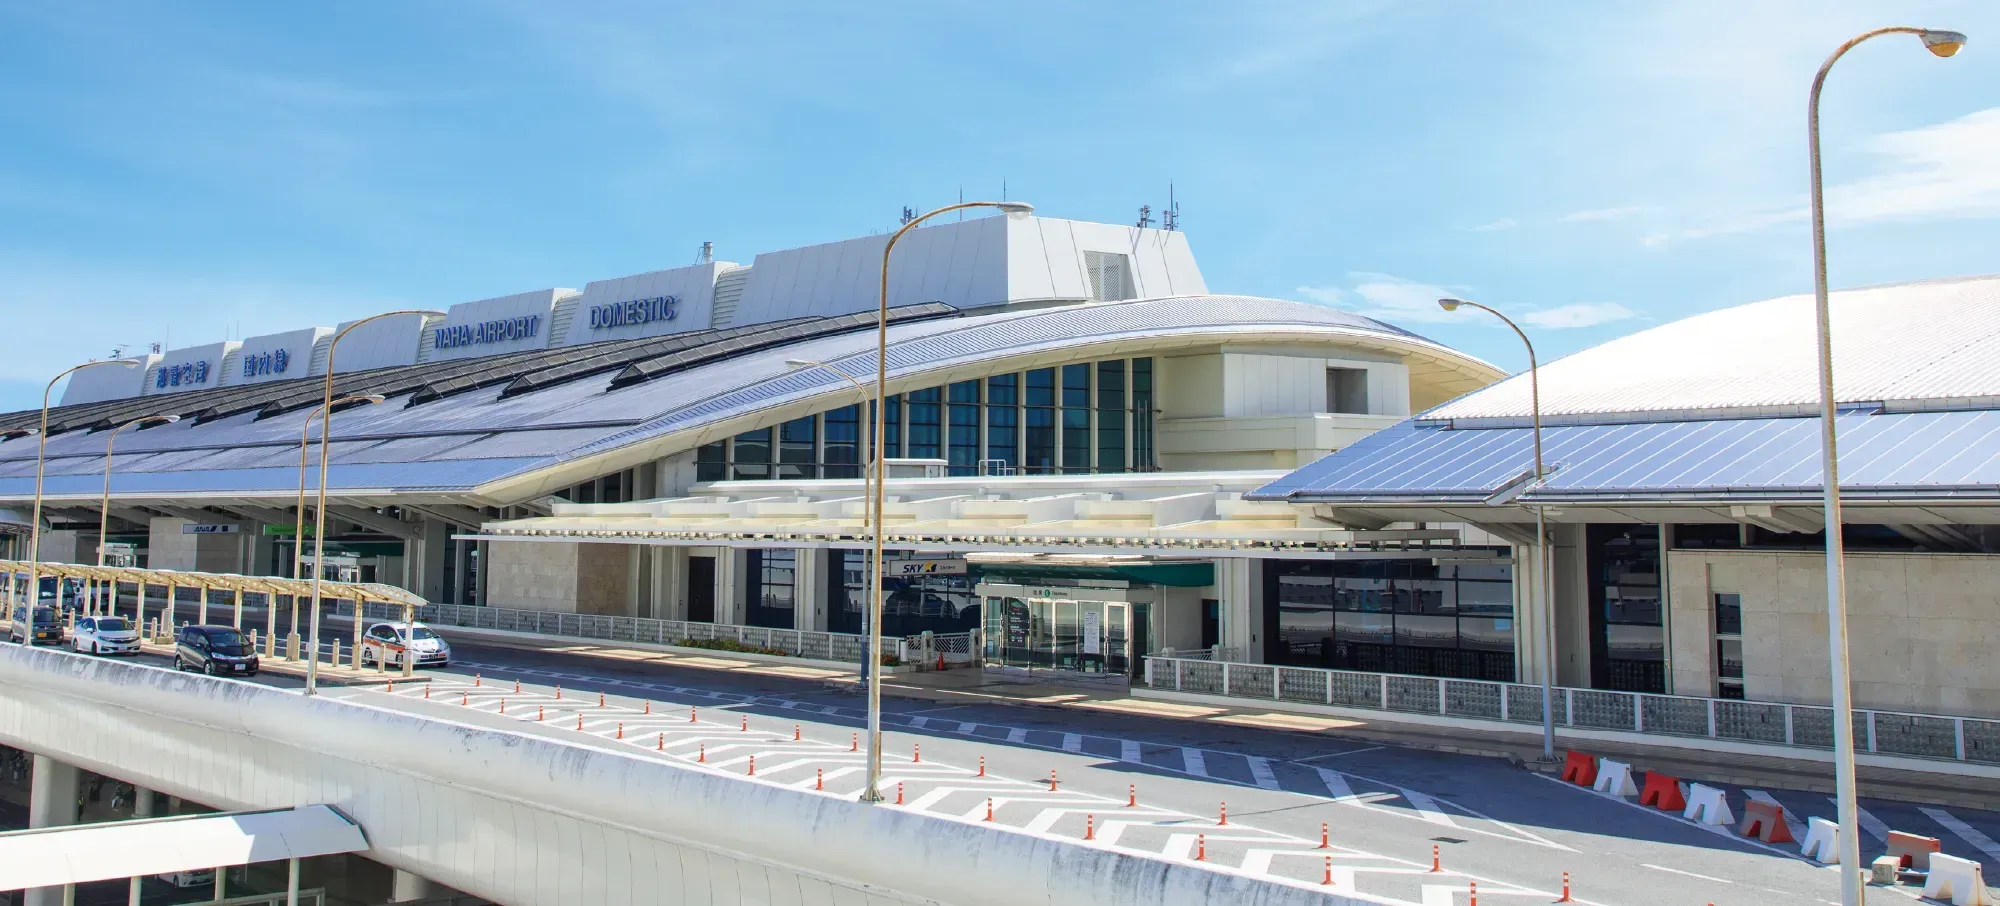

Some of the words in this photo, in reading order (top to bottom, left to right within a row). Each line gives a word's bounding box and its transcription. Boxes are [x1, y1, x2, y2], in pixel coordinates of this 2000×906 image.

[589, 296, 677, 329] DOMESTIC
[435, 323, 471, 349] NAHA
[475, 315, 537, 345] AIRPORT
[244, 348, 286, 377] 国内線
[903, 564, 924, 574] SKY
